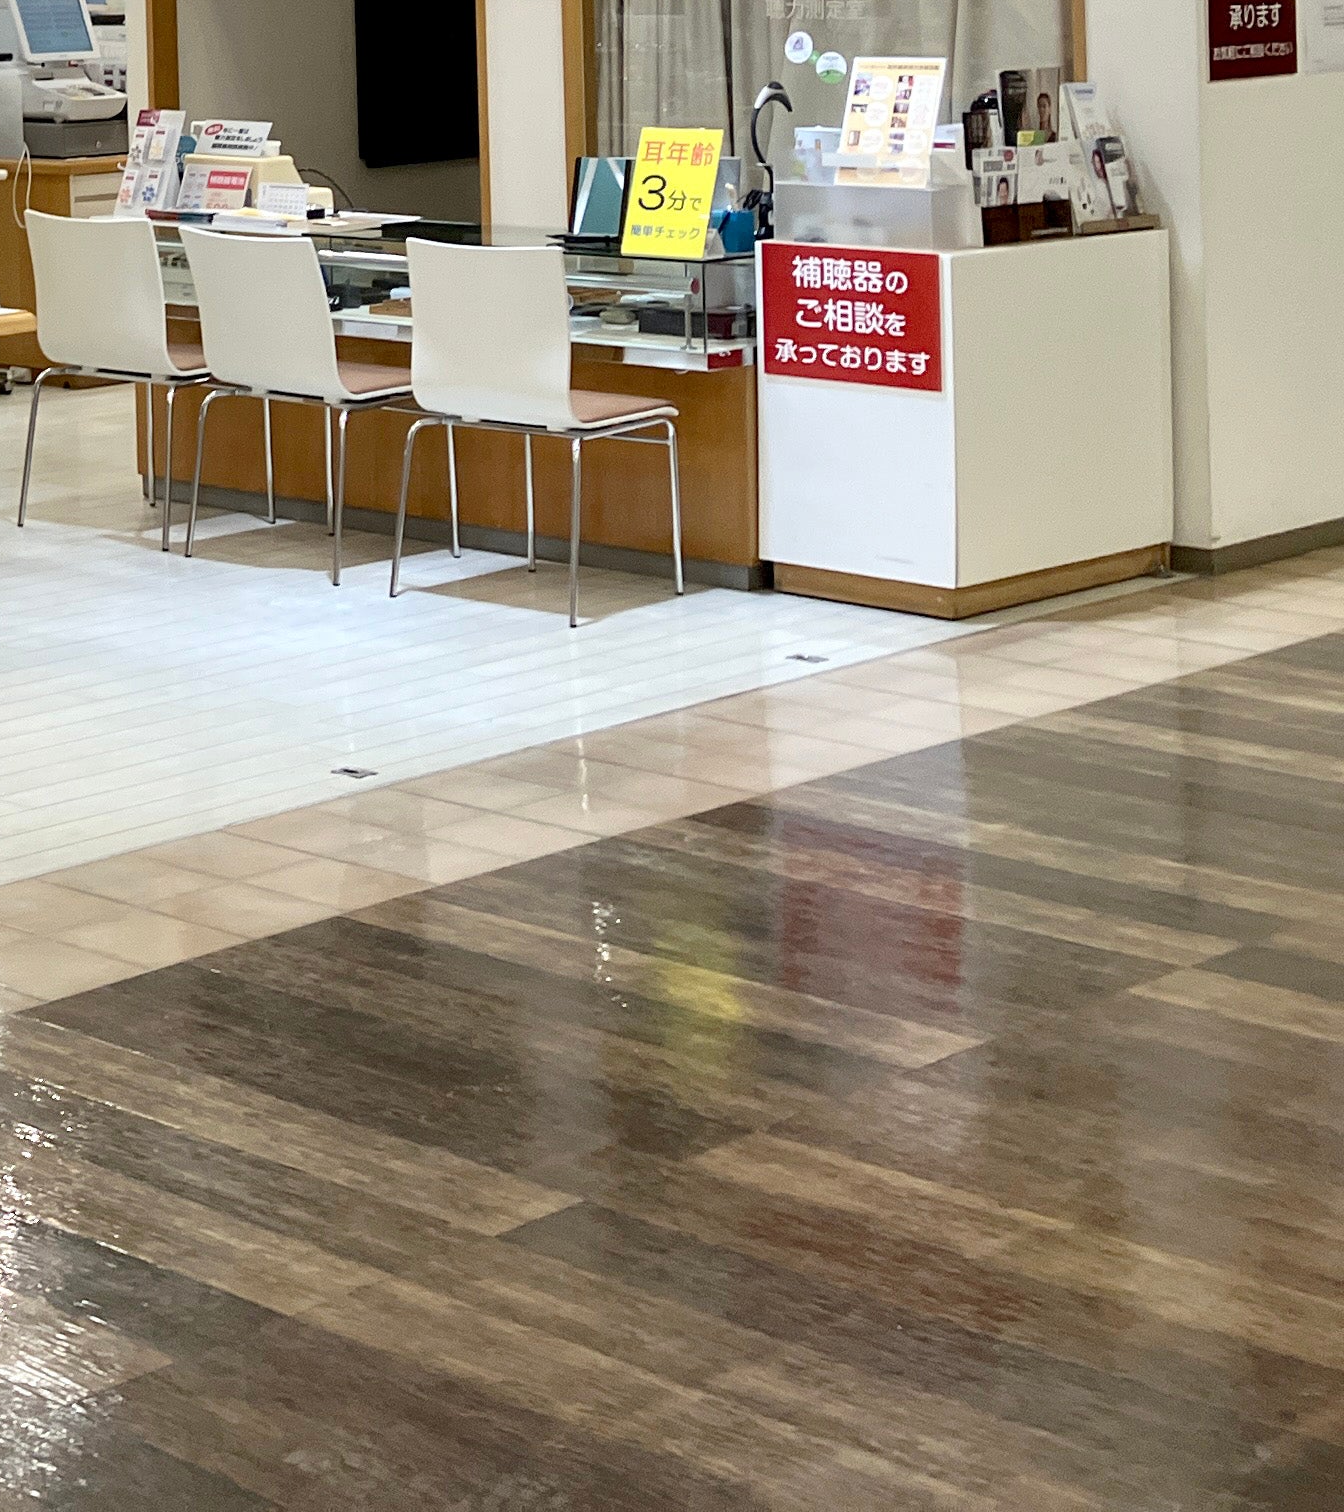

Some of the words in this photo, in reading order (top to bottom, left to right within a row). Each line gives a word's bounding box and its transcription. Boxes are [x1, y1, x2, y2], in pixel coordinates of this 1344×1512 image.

[1228, 2, 1282, 30] 承ります
[642, 140, 715, 167] 耳年齢
[638, 174, 703, 212] 3分で
[631, 224, 700, 240] 簡単チェック
[792, 255, 909, 295] 補聴器の
[795, 298, 906, 337] ご相談を
[775, 338, 930, 376] 承っております
